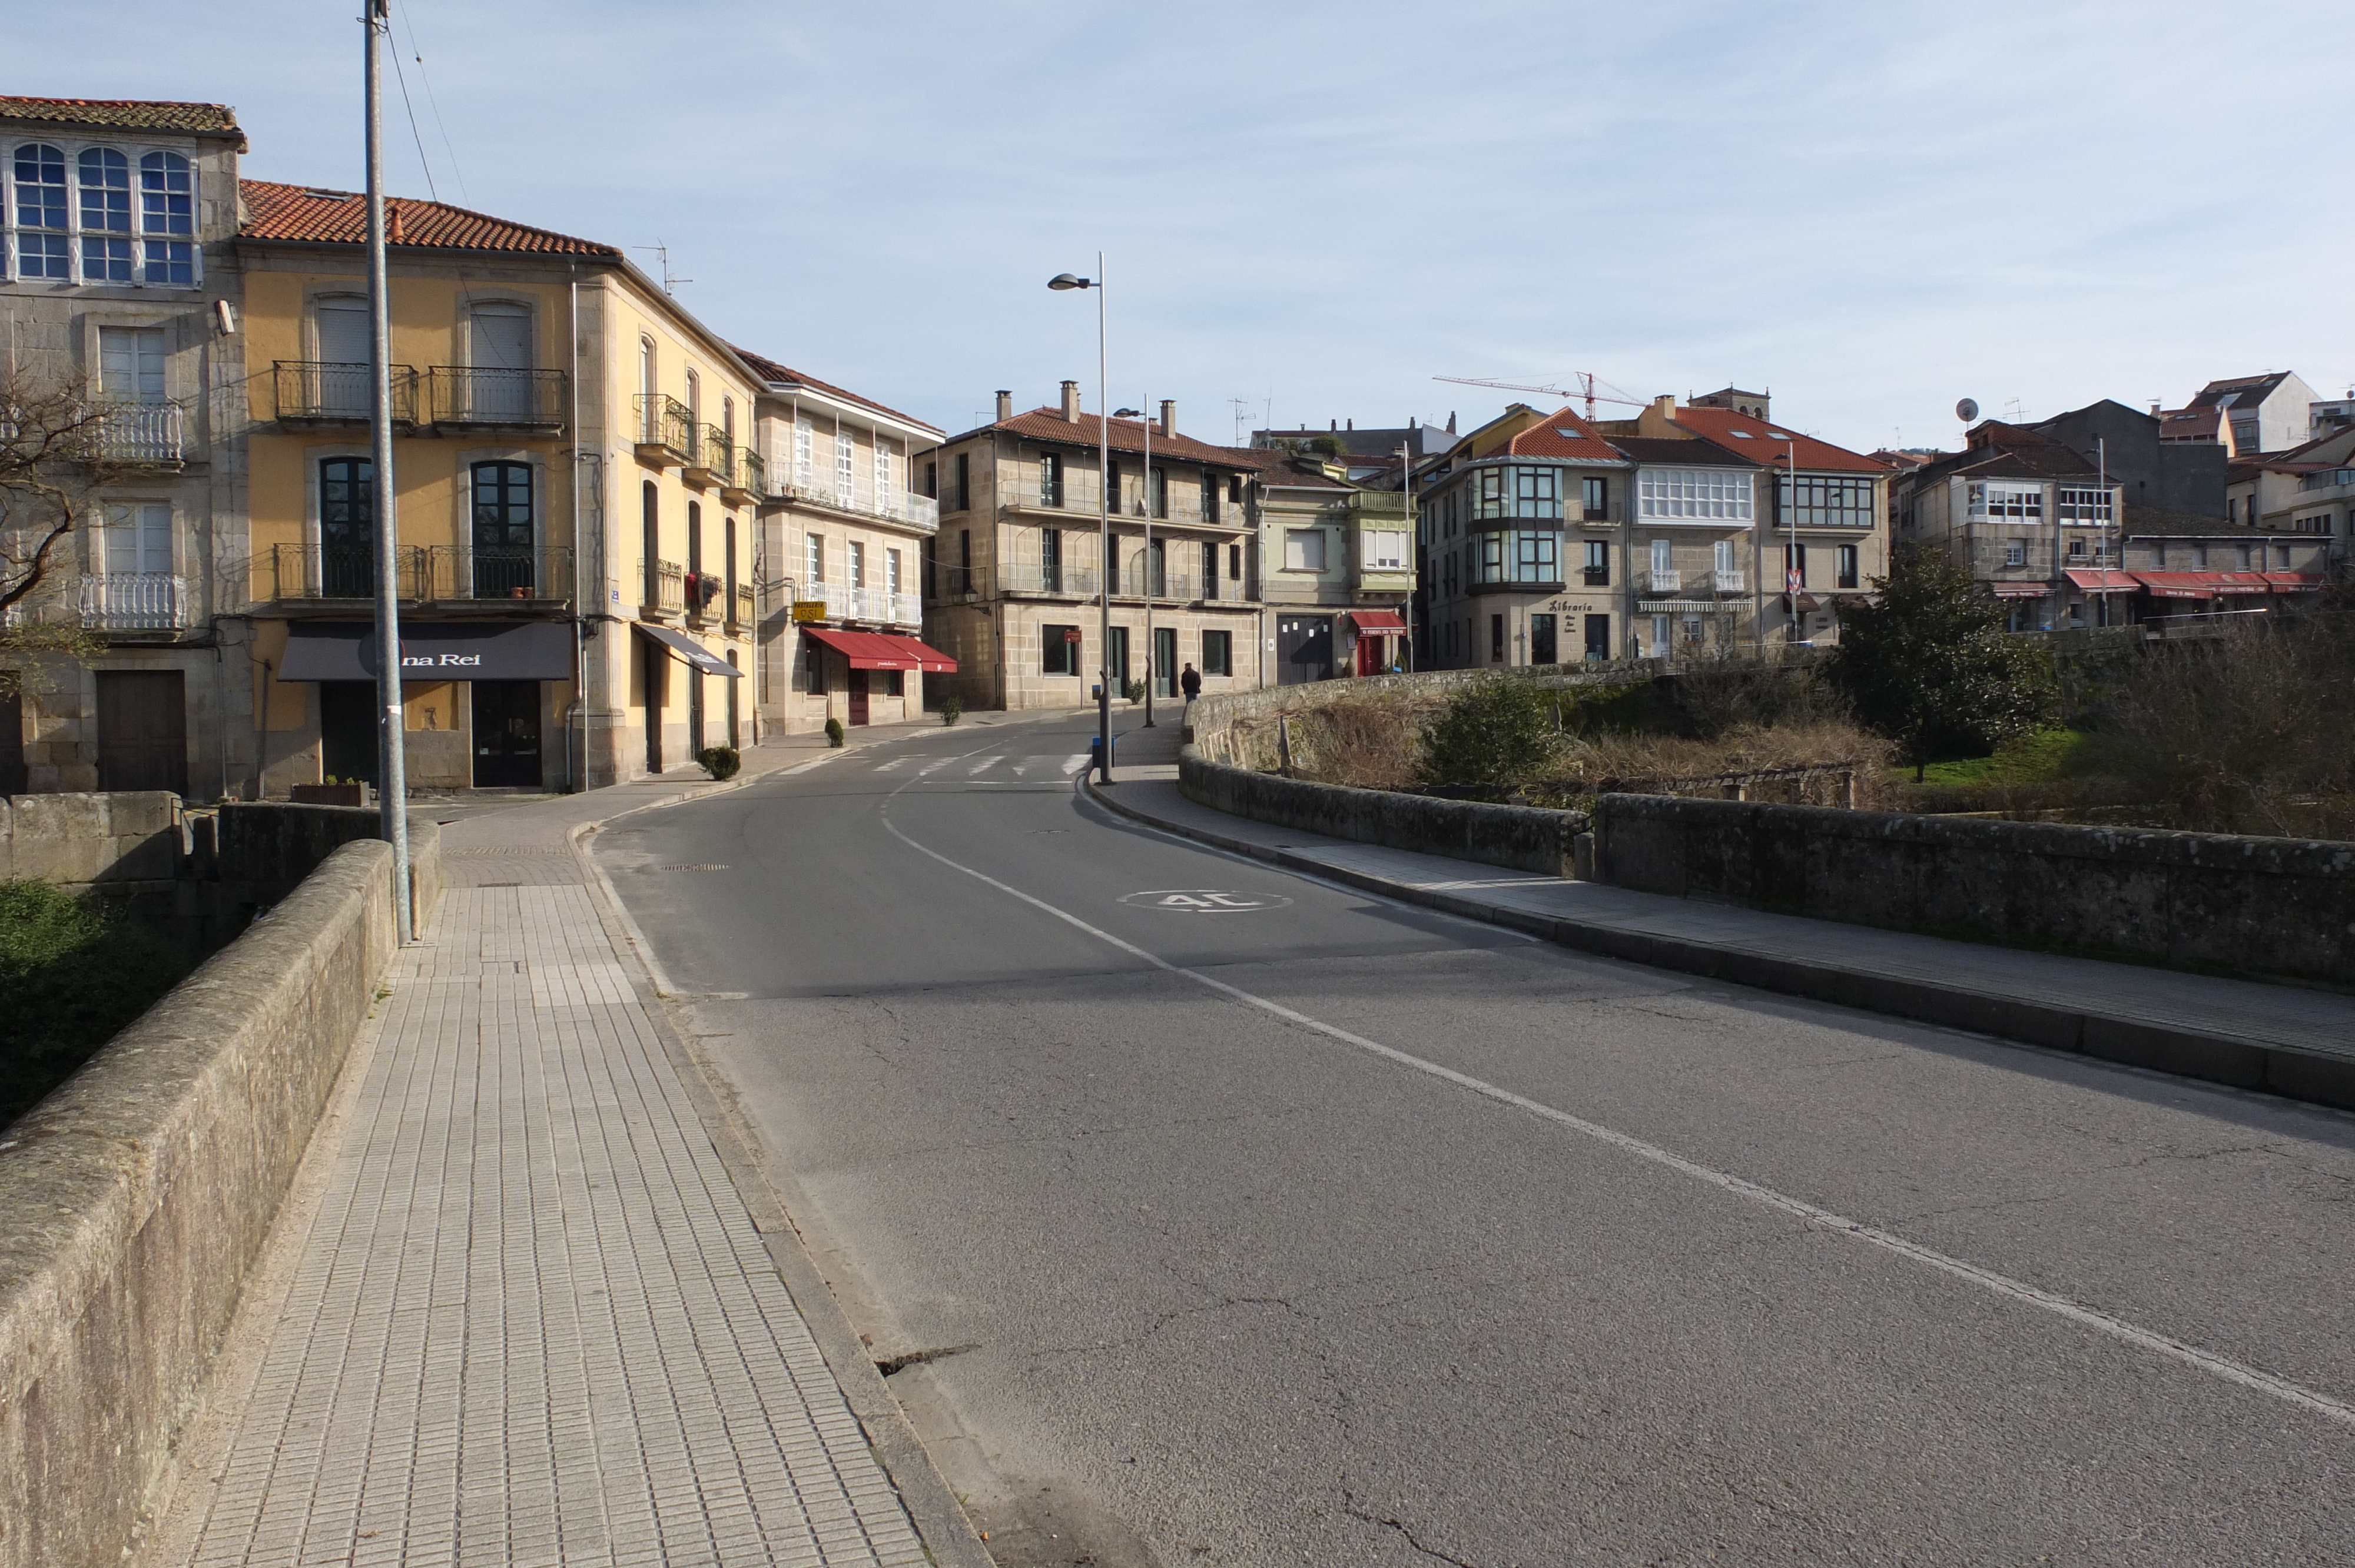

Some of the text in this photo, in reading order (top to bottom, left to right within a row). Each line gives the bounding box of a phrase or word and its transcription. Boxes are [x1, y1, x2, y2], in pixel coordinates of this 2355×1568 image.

[1548, 600, 1593, 612] Libraría
[402, 654, 482, 666] na Rei
